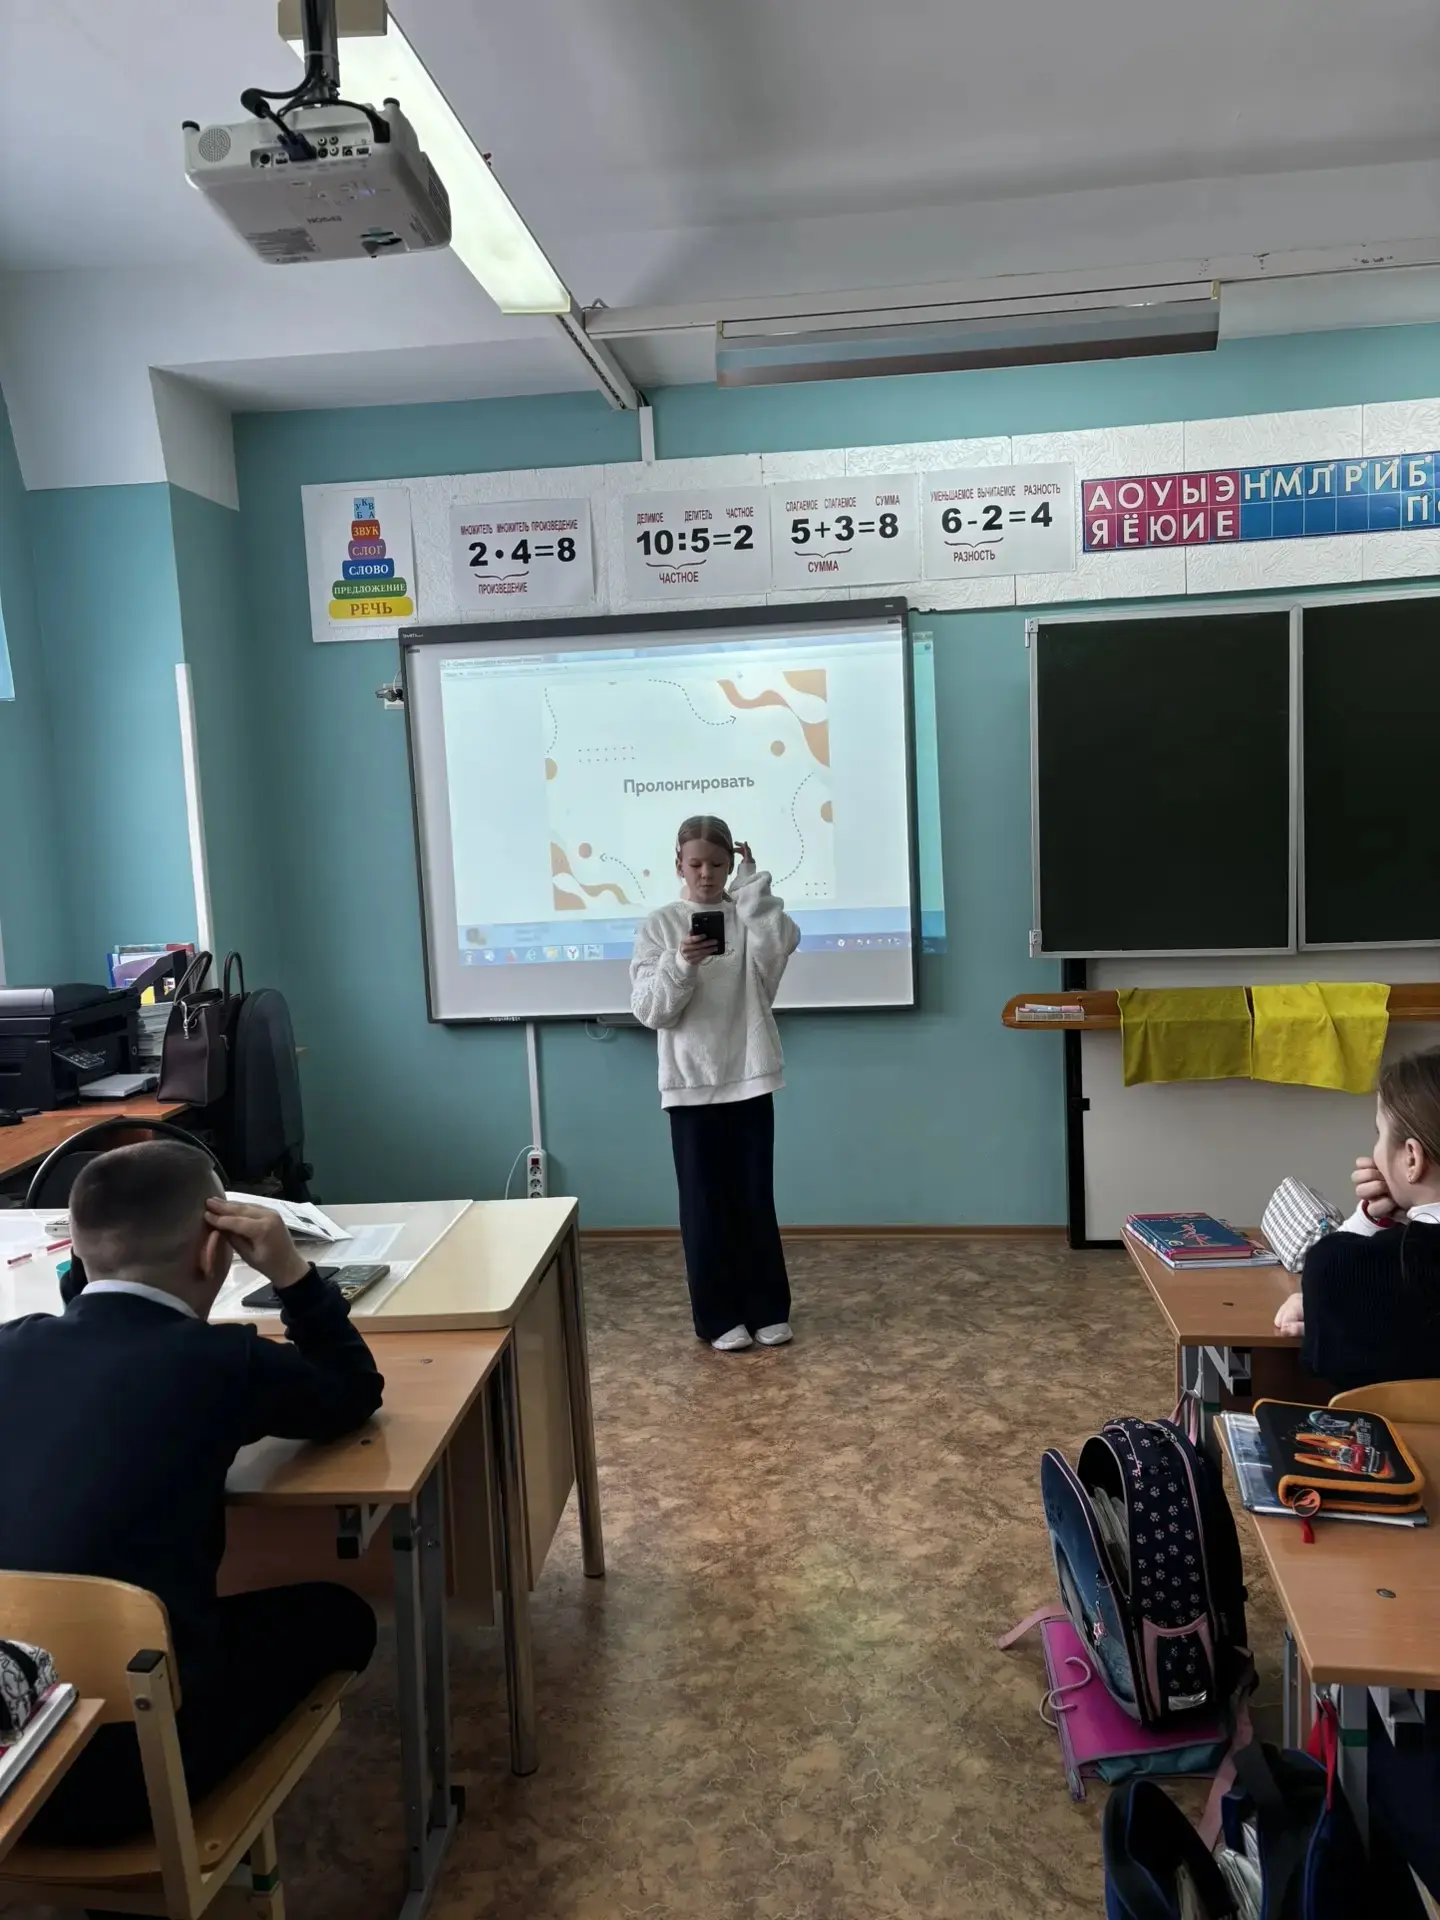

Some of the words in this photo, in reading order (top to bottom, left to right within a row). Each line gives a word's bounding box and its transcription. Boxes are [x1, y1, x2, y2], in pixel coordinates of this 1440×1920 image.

[930, 488, 974, 502] УМЕНЬШАЕМОЕ
[977, 485, 1016, 498] ВЫЧИТАЕМОЕ
[1023, 483, 1061, 496] РАЗНОСТЬ
[785, 499, 818, 512] СЛАГАЕМОЕ
[824, 496, 856, 509] СЛАГАЕМОЕ
[875, 495, 900, 506] СУММА
[636, 512, 664, 525] ДЕЛИМОЕ
[684, 509, 713, 522] ДЕЛИТЕЛЬ
[725, 506, 754, 518] ЧАСТНОЕ
[352, 526, 379, 536] ЗВУК
[460, 524, 493, 535] МНОЖИТЕЛЬ
[496, 521, 529, 533] МНОЖИТЕЛЬ
[531, 519, 578, 532] ПРОИЗВЕДЕНИЕ
[352, 545, 383, 556] СЛОГ
[953, 550, 996, 562] РАЗНОСТЬ
[348, 564, 389, 576] СЛОВО
[808, 560, 839, 573] СУММА
[659, 571, 699, 584] ЧАСТНОЕ
[334, 583, 406, 595] ПРЕДЛОЖЕНИЕ
[478, 582, 527, 594] ПРОИЗВЕДЕНИЕ
[350, 602, 393, 616] РЕЧЬ
[623, 777, 755, 797] Пролонгировать
